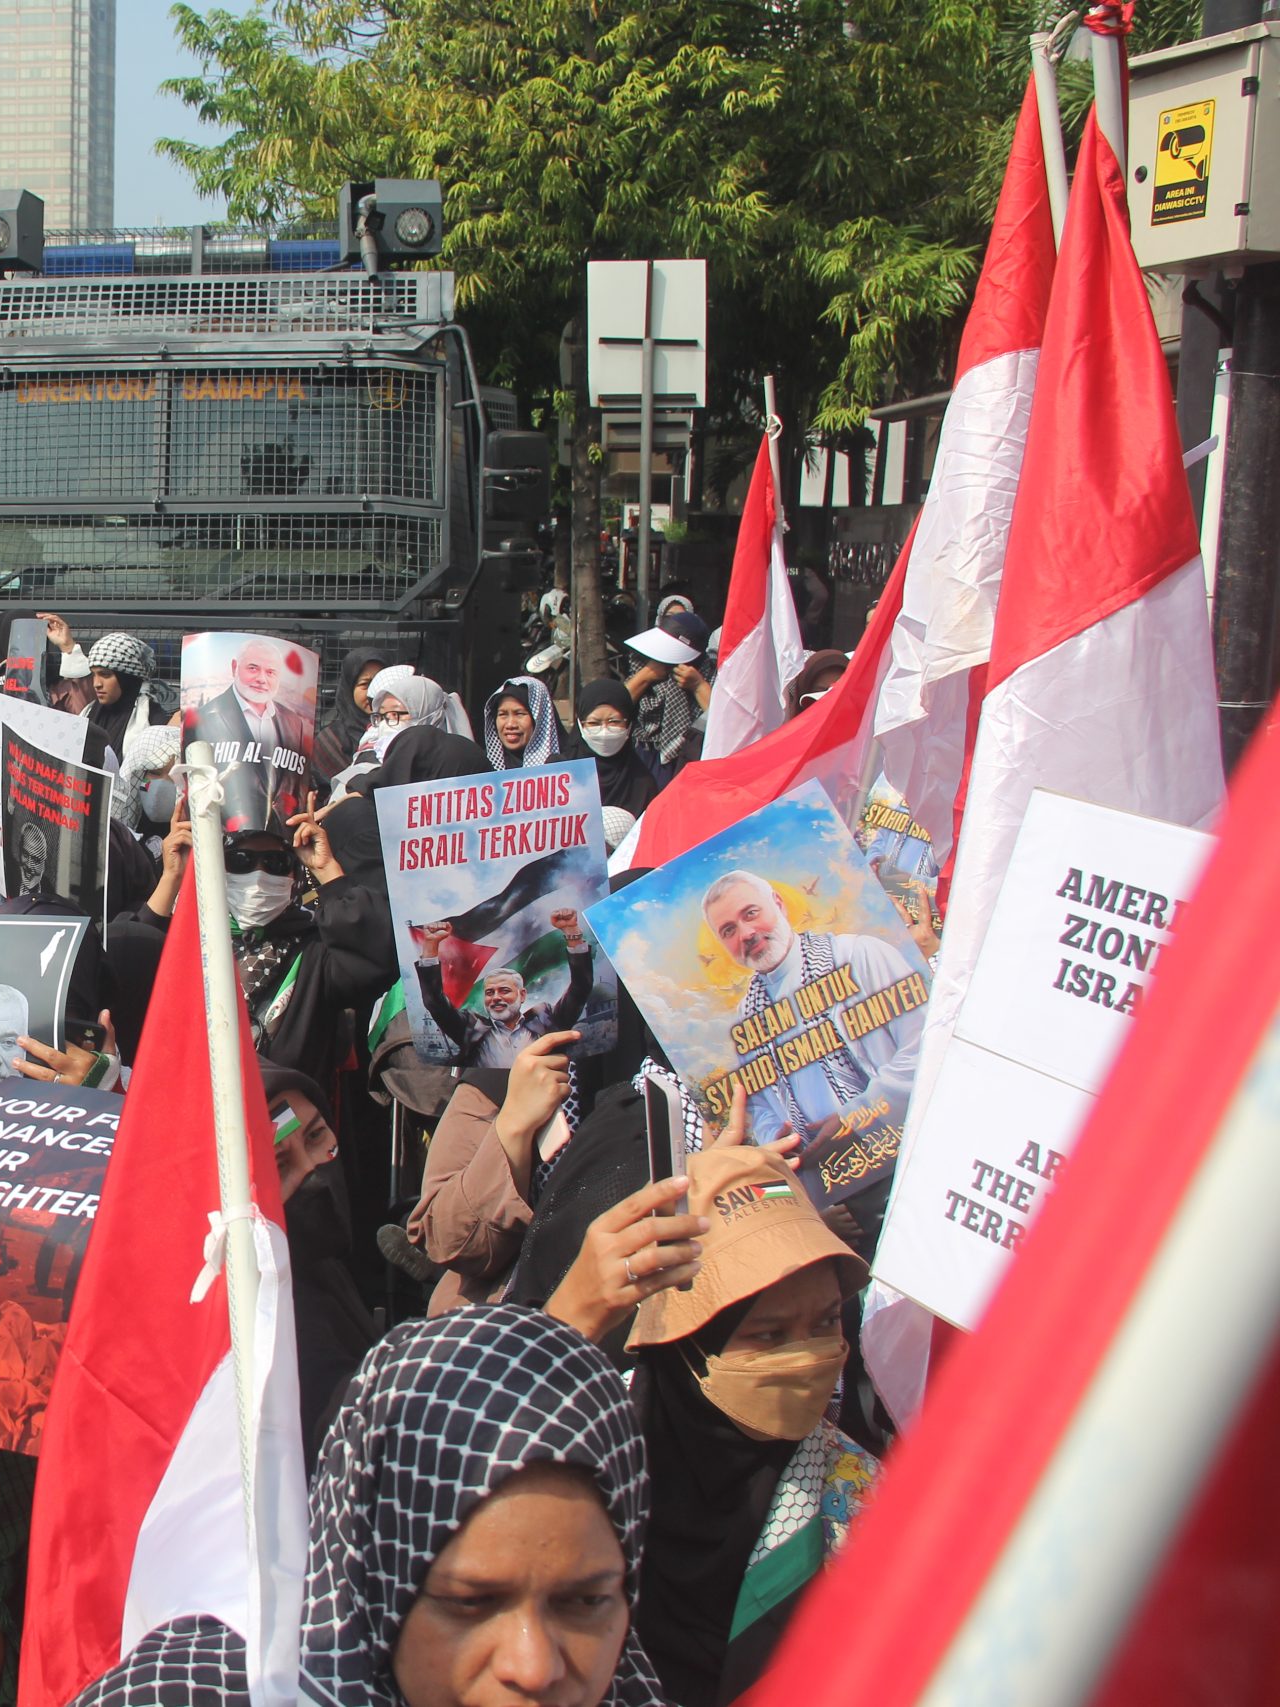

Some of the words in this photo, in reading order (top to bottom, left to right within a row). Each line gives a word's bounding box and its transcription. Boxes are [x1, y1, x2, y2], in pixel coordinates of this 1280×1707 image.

[1154, 200, 1184, 212] DIAWASI
[1184, 195, 1205, 207] CCTV
[1165, 189, 1184, 199] AREA
[1185, 186, 1195, 196] INI
[17, 379, 157, 403] DIREKTORA
[184, 376, 306, 400] SAMAPTA
[242, 741, 306, 775] AL-QUDS
[35, 759, 93, 796] NAFASKU
[28, 776, 91, 817] TERTIMBUN
[407, 784, 494, 829] ENTITAS
[501, 773, 571, 815] ZIONIS
[38, 803, 80, 833] TANAH
[865, 803, 910, 834] SYAHID
[399, 831, 468, 872] ISRAIL
[478, 813, 589, 861] TERKUTUK
[1052, 957, 1144, 1019] ISRA
[730, 996, 799, 1056] SALAM
[794, 962, 861, 1021] UNTUK
[704, 1053, 780, 1116] SYAHID
[776, 1019, 844, 1077] ISMAIL
[841, 972, 929, 1042] HANIYEH
[713, 1185, 756, 1217] SAV
[971, 1158, 1036, 1215] THE
[721, 1198, 801, 1227] PALESTINE
[944, 1188, 1027, 1251] TERR
